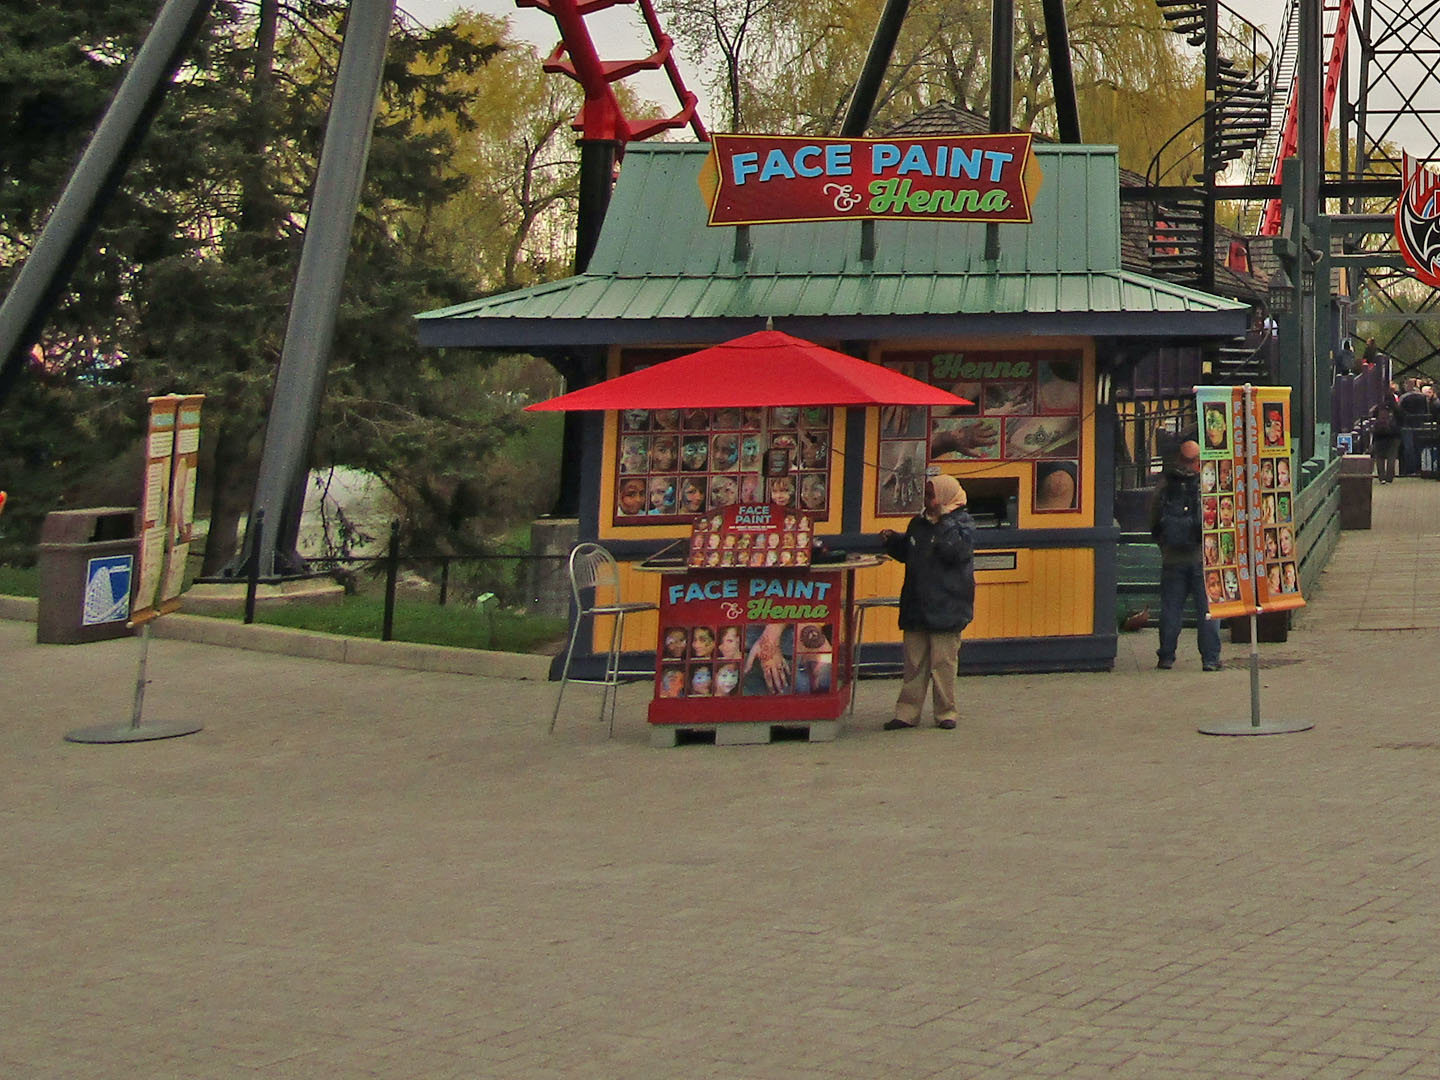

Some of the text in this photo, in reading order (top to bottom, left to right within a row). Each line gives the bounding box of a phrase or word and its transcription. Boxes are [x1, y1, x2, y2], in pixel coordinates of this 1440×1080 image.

[731, 143, 1013, 185] FACE PAINT
[823, 178, 1011, 213] & Henna
[932, 352, 1033, 379] Henna
[1234, 401, 1250, 580] FACE PAINTING
[735, 514, 771, 524] PAINT
[738, 505, 770, 515] FACE
[668, 579, 832, 605] FACE PAINT
[720, 598, 830, 620] & Henna
